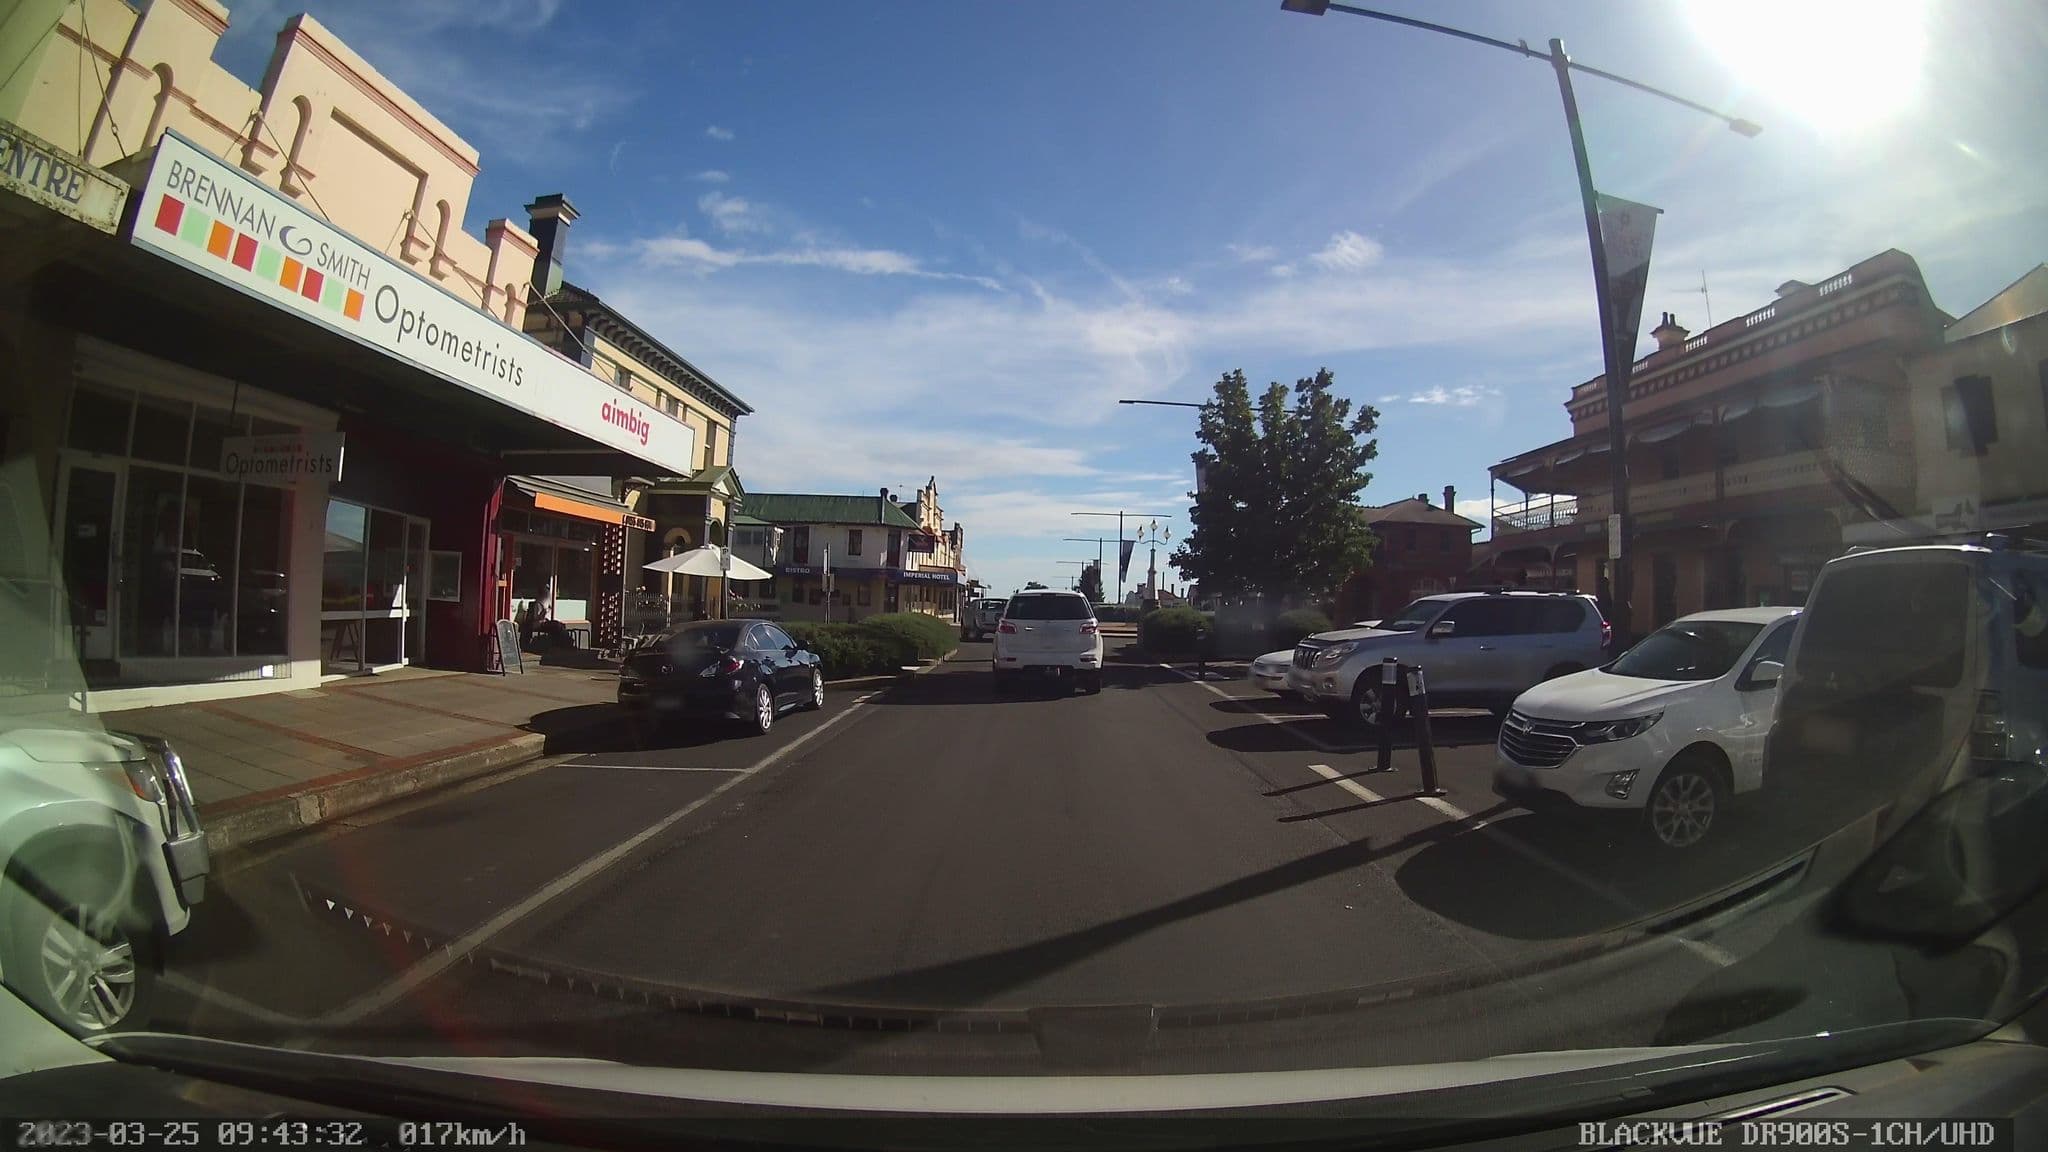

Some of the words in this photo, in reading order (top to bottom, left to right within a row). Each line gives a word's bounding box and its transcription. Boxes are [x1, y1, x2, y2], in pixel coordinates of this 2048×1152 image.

[166, 159, 277, 241] BRENNAN
[316, 242, 372, 291] SMITH
[374, 284, 524, 388] Optometrists
[601, 398, 650, 446] aimbig
[226, 450, 334, 480] Optometrists
[903, 571, 931, 580] IMPERIAL
[932, 573, 950, 581] HOTEL
